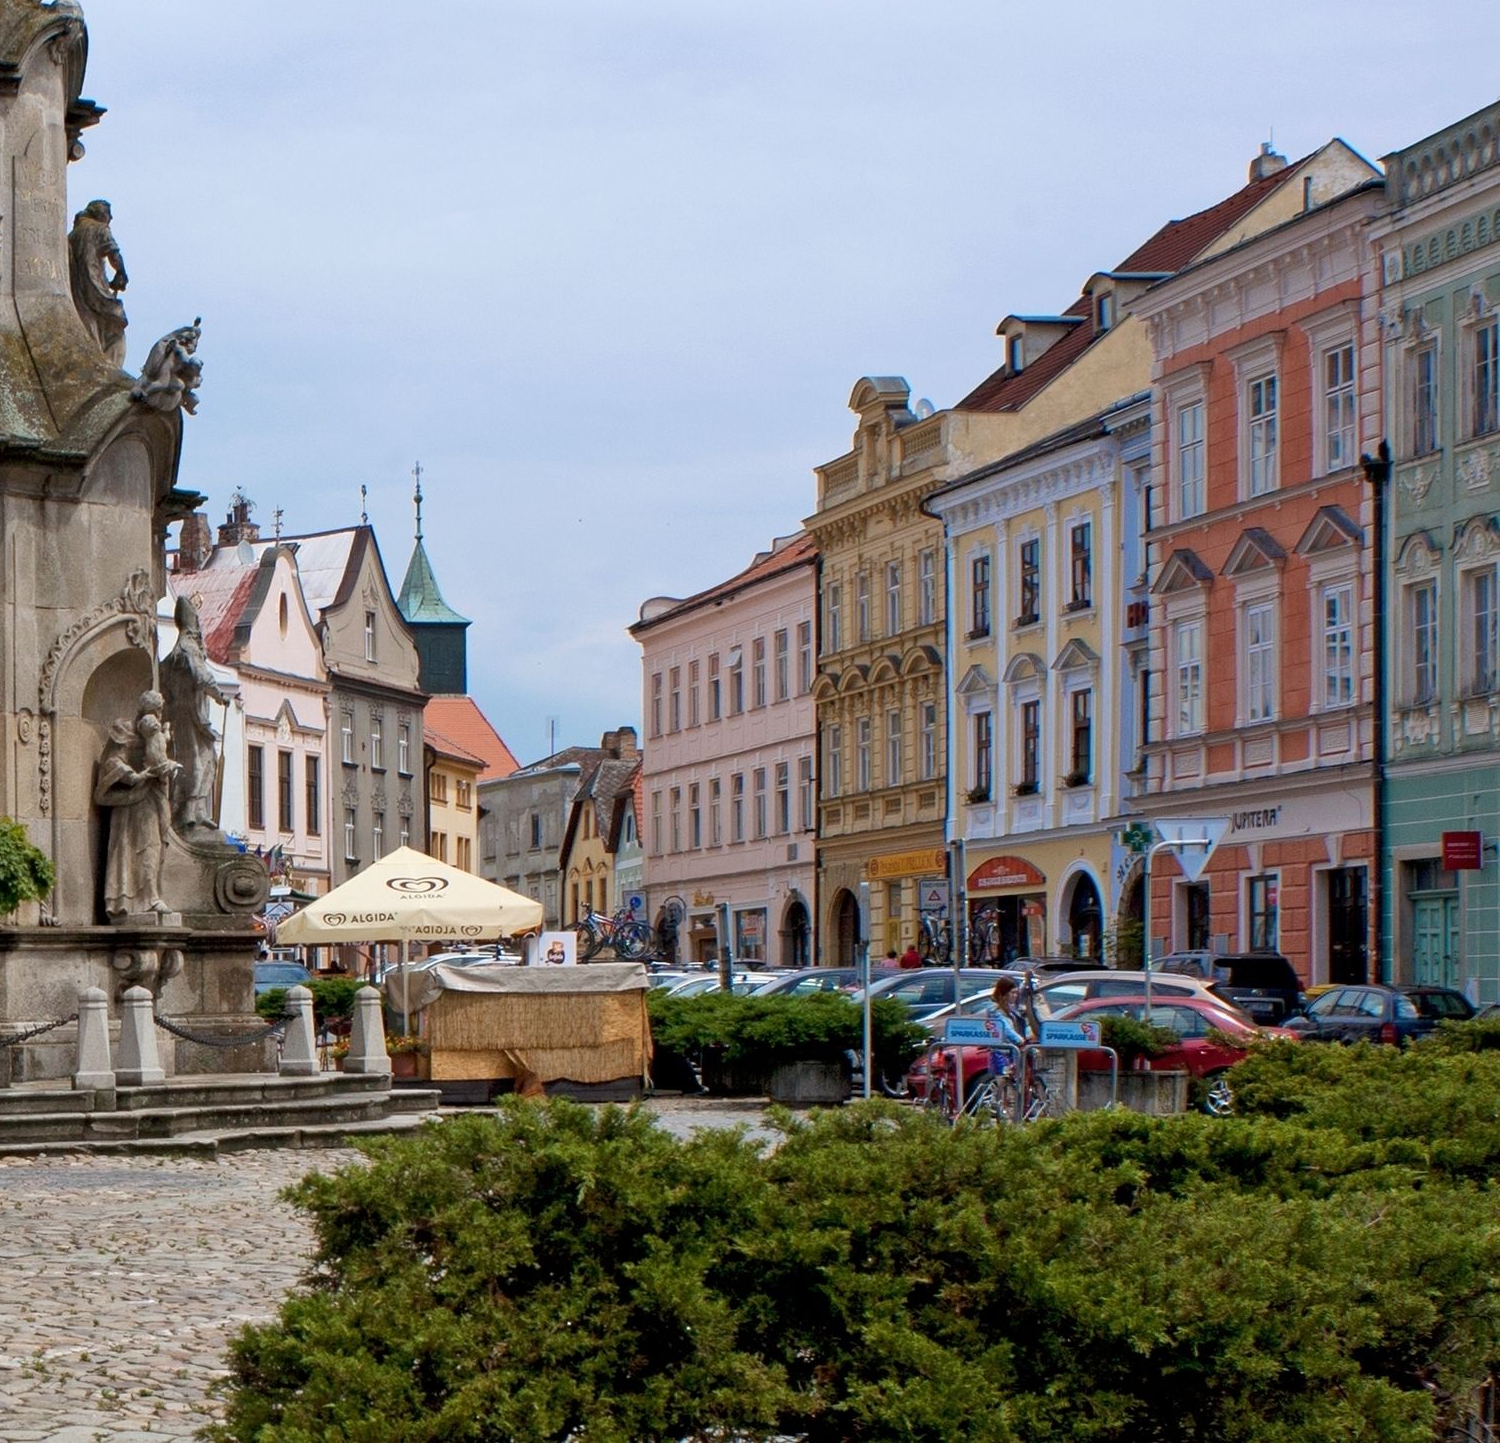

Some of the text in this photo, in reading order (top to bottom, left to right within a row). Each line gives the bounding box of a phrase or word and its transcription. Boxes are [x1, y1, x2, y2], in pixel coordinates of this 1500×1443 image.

[350, 913, 395, 924] ALGIDA
[950, 1030, 991, 1039] SPARKASSE
[1045, 1033, 1086, 1041] SPARKASSE
